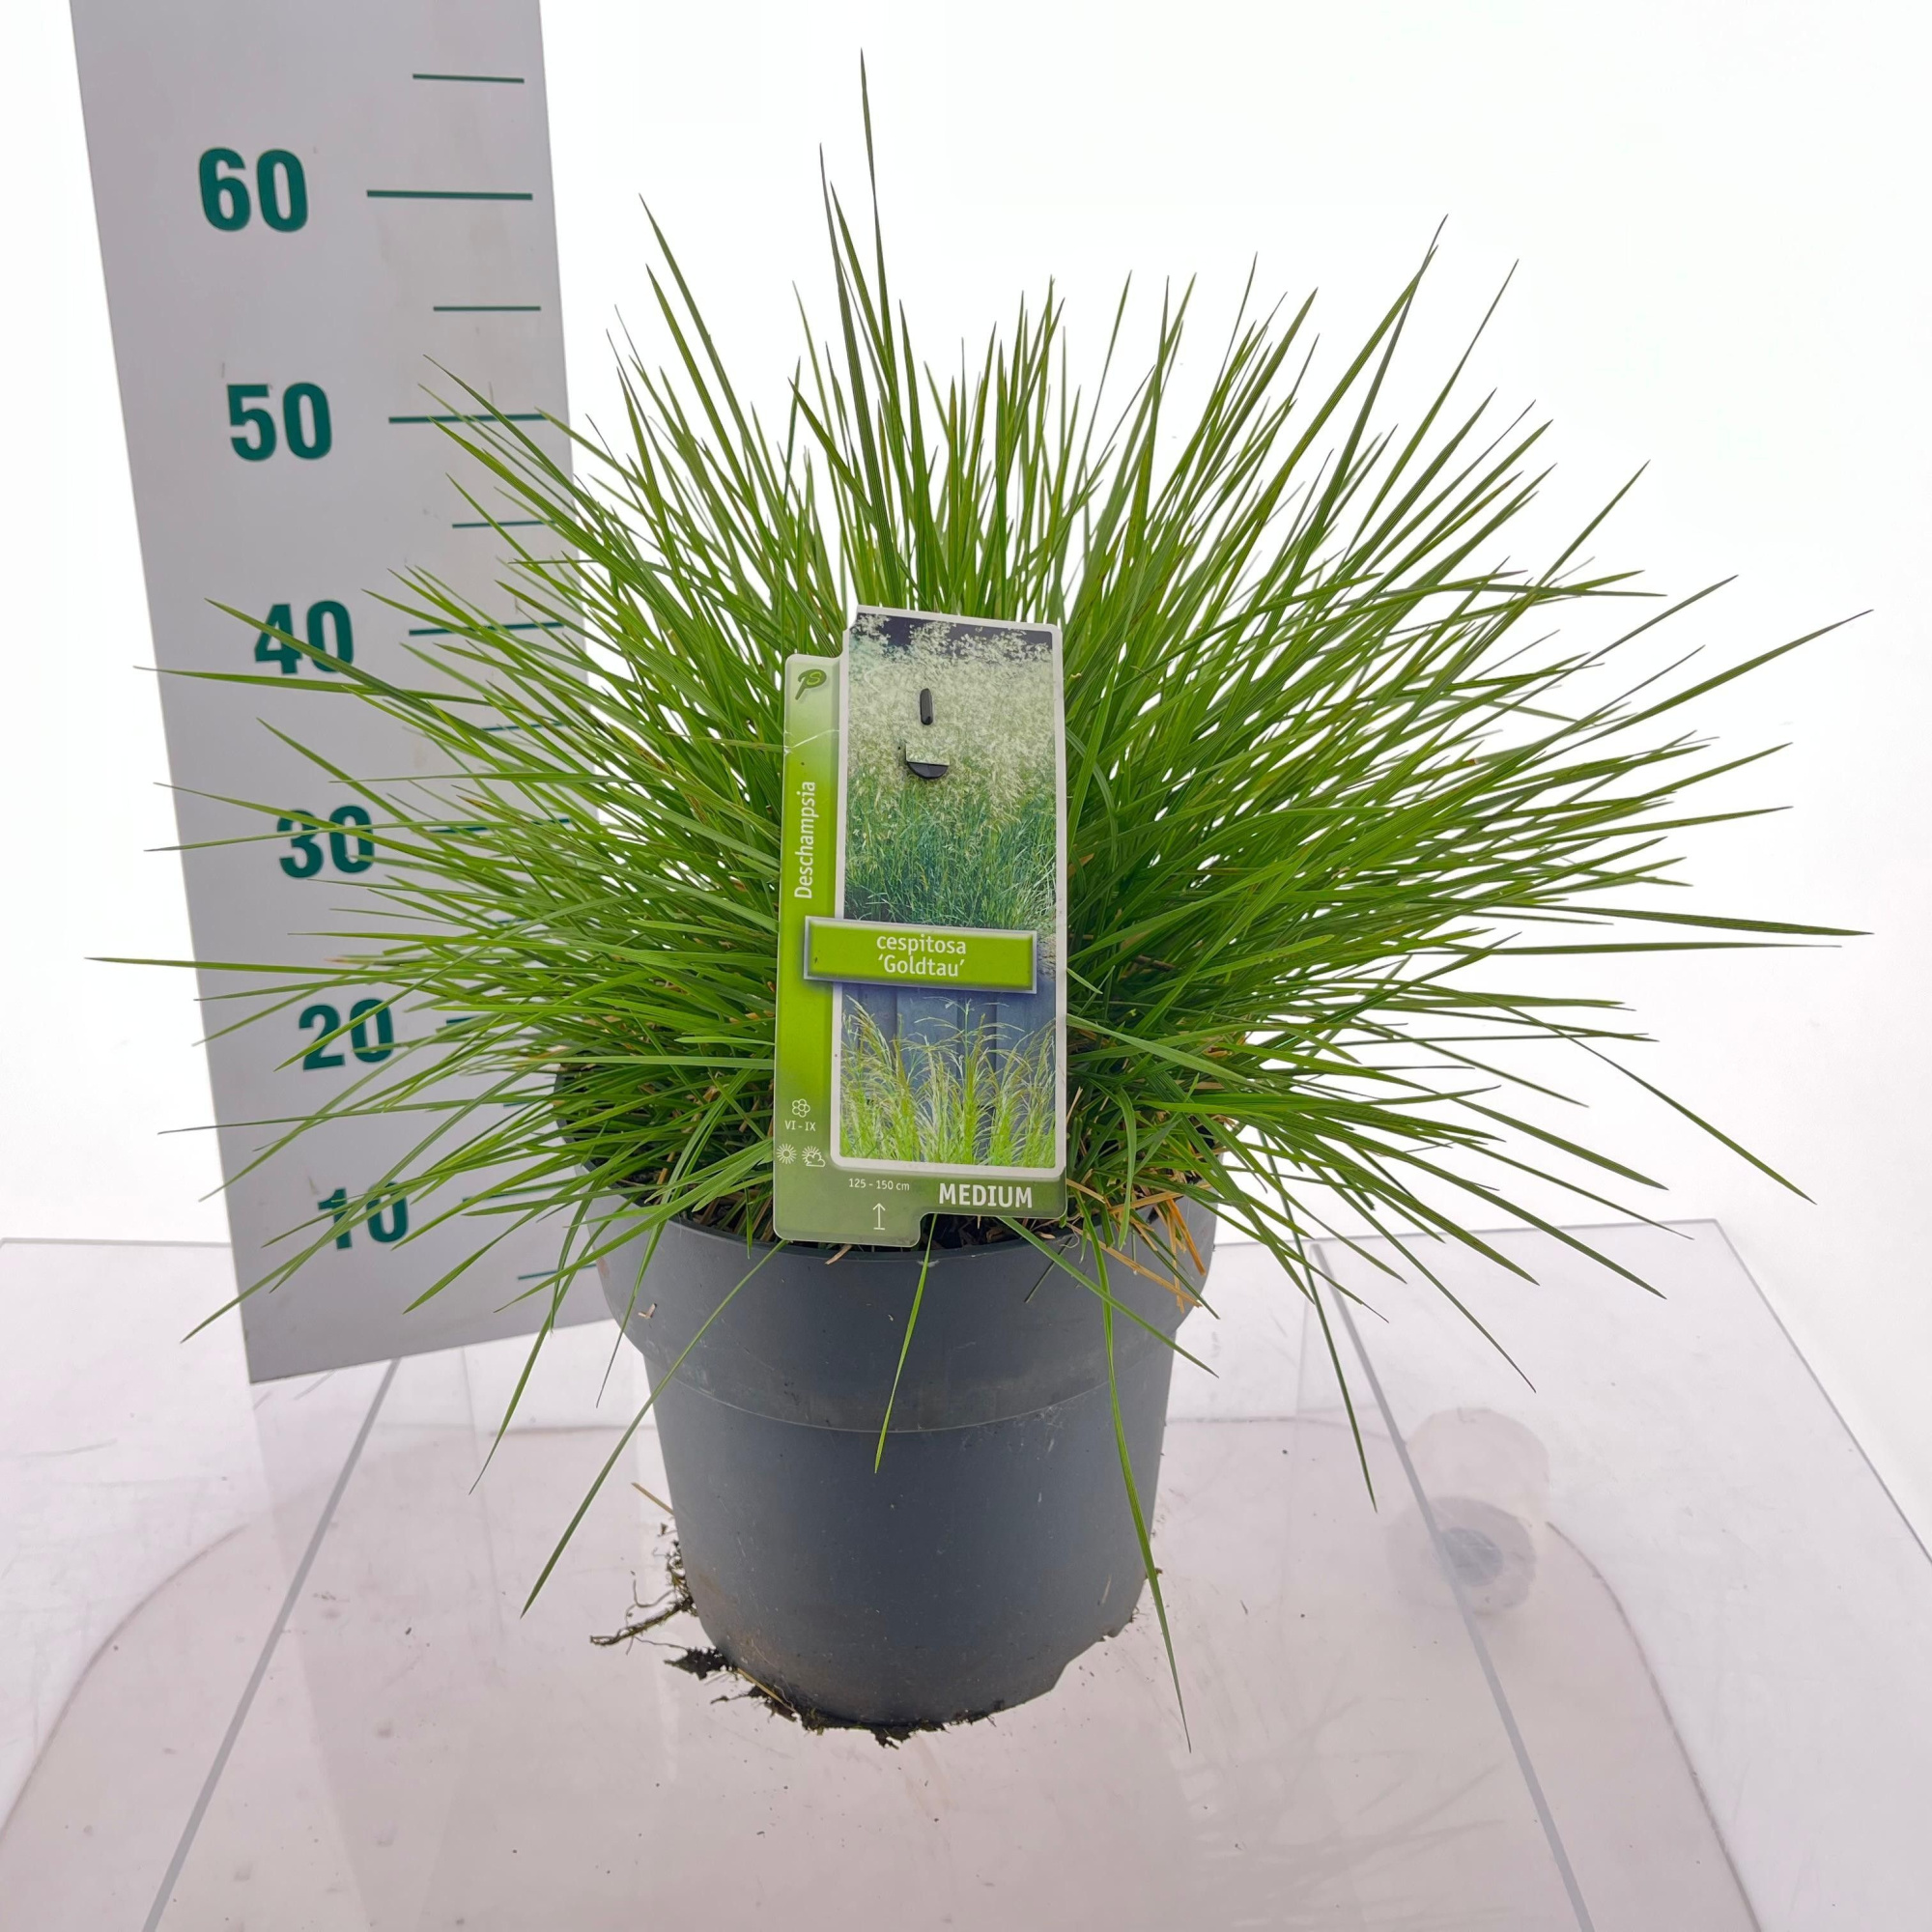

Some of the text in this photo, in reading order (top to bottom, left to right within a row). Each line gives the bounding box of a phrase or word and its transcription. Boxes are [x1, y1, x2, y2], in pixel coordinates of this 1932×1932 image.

[198, 147, 308, 233] 60
[226, 382, 333, 462] 50
[253, 599, 355, 675] 40
[276, 806, 375, 878] 30
[793, 781, 819, 899] Deschampsia
[876, 934, 967, 954] cespitosa
[298, 999, 394, 1070] 20
[317, 1180, 410, 1250] 10
[848, 1178, 867, 1188] 125
[876, 1179, 894, 1189] 150
[895, 1181, 910, 1191] cm
[939, 1182, 1033, 1208] MEDIUM
